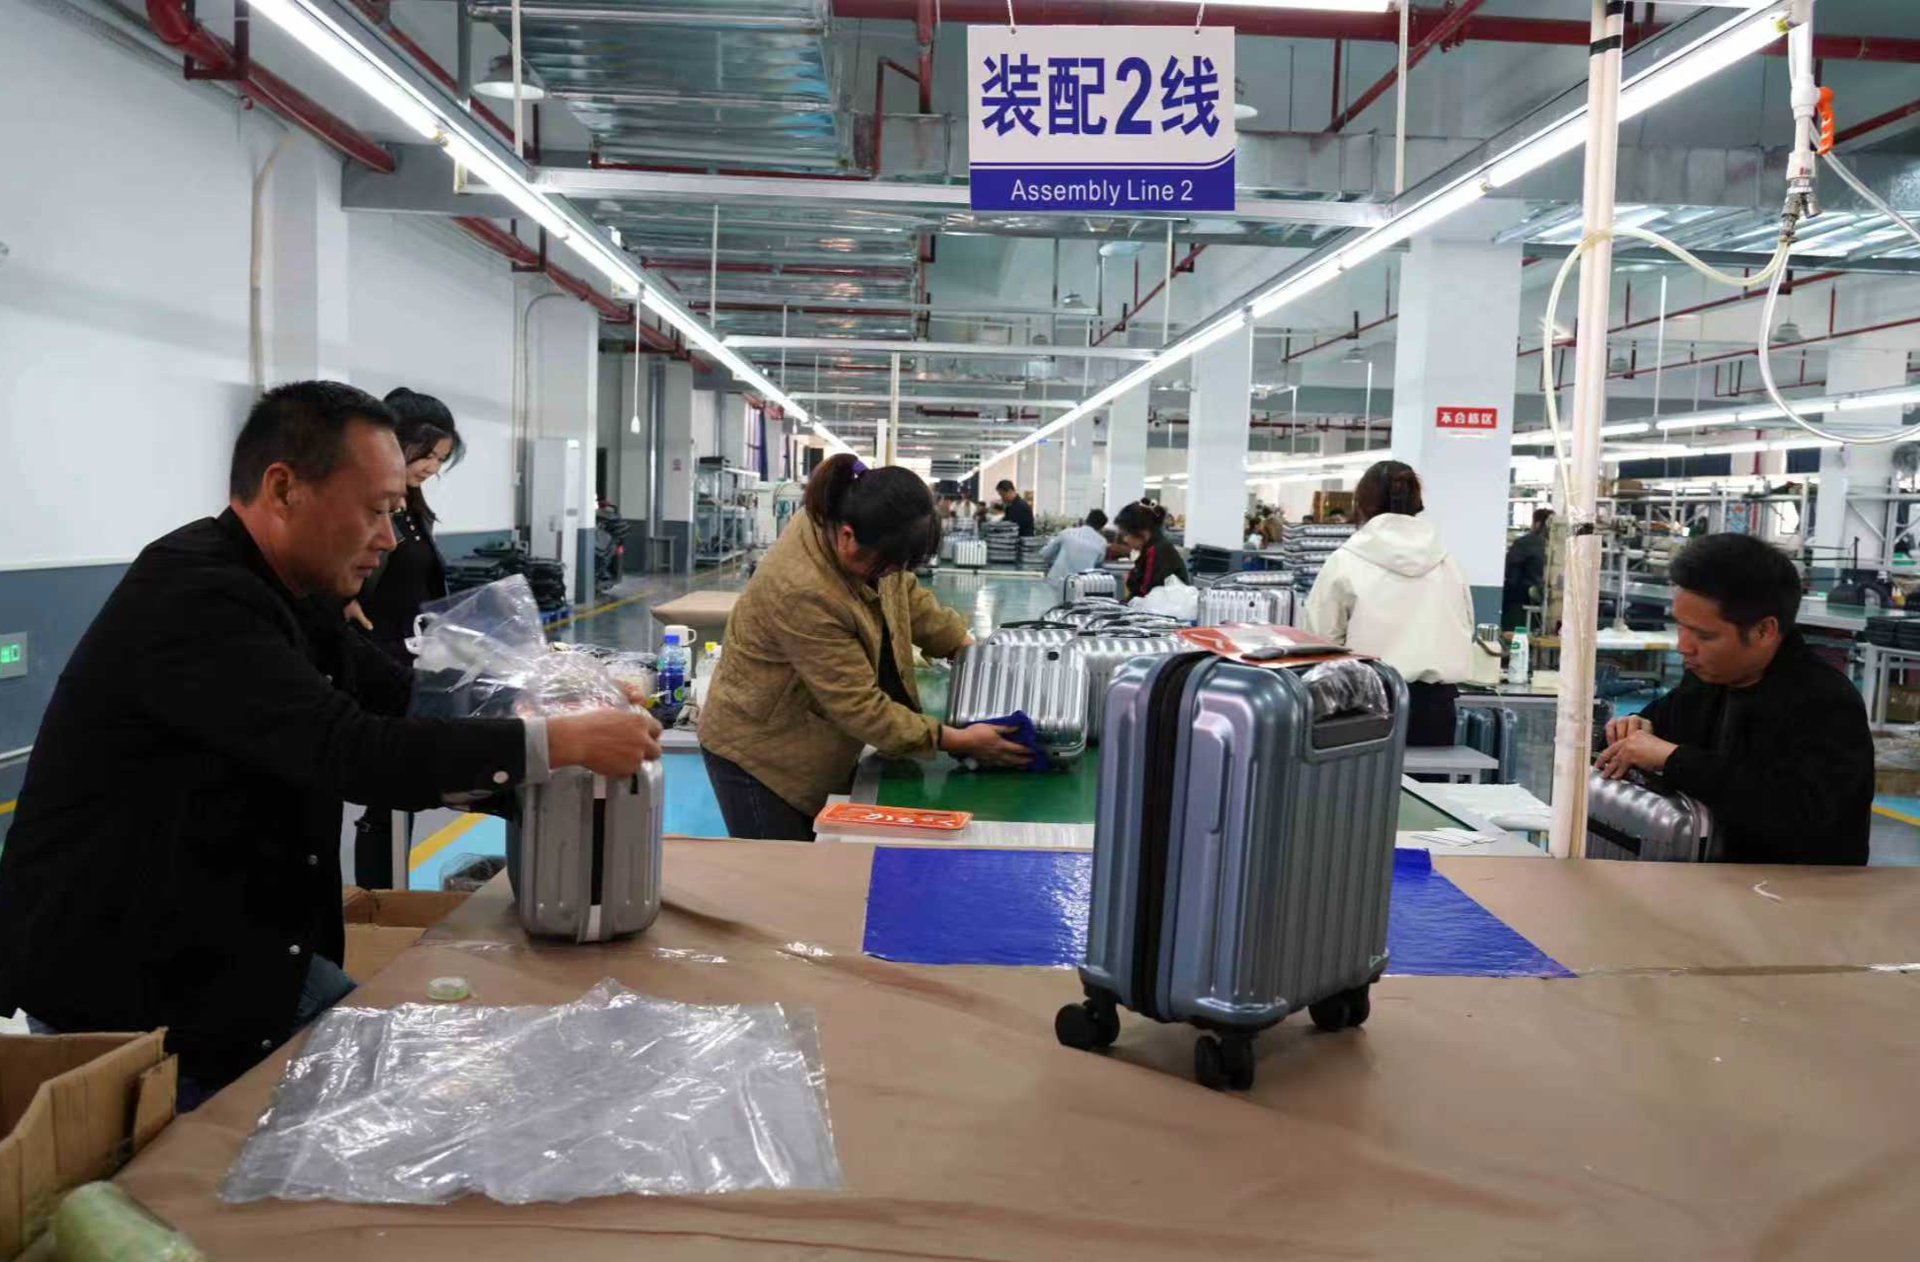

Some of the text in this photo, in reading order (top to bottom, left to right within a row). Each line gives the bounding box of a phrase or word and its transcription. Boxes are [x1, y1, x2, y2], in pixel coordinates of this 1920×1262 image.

[981, 53, 1220, 138] 装配2线
[1010, 178, 1193, 206] Assembly Line 2
